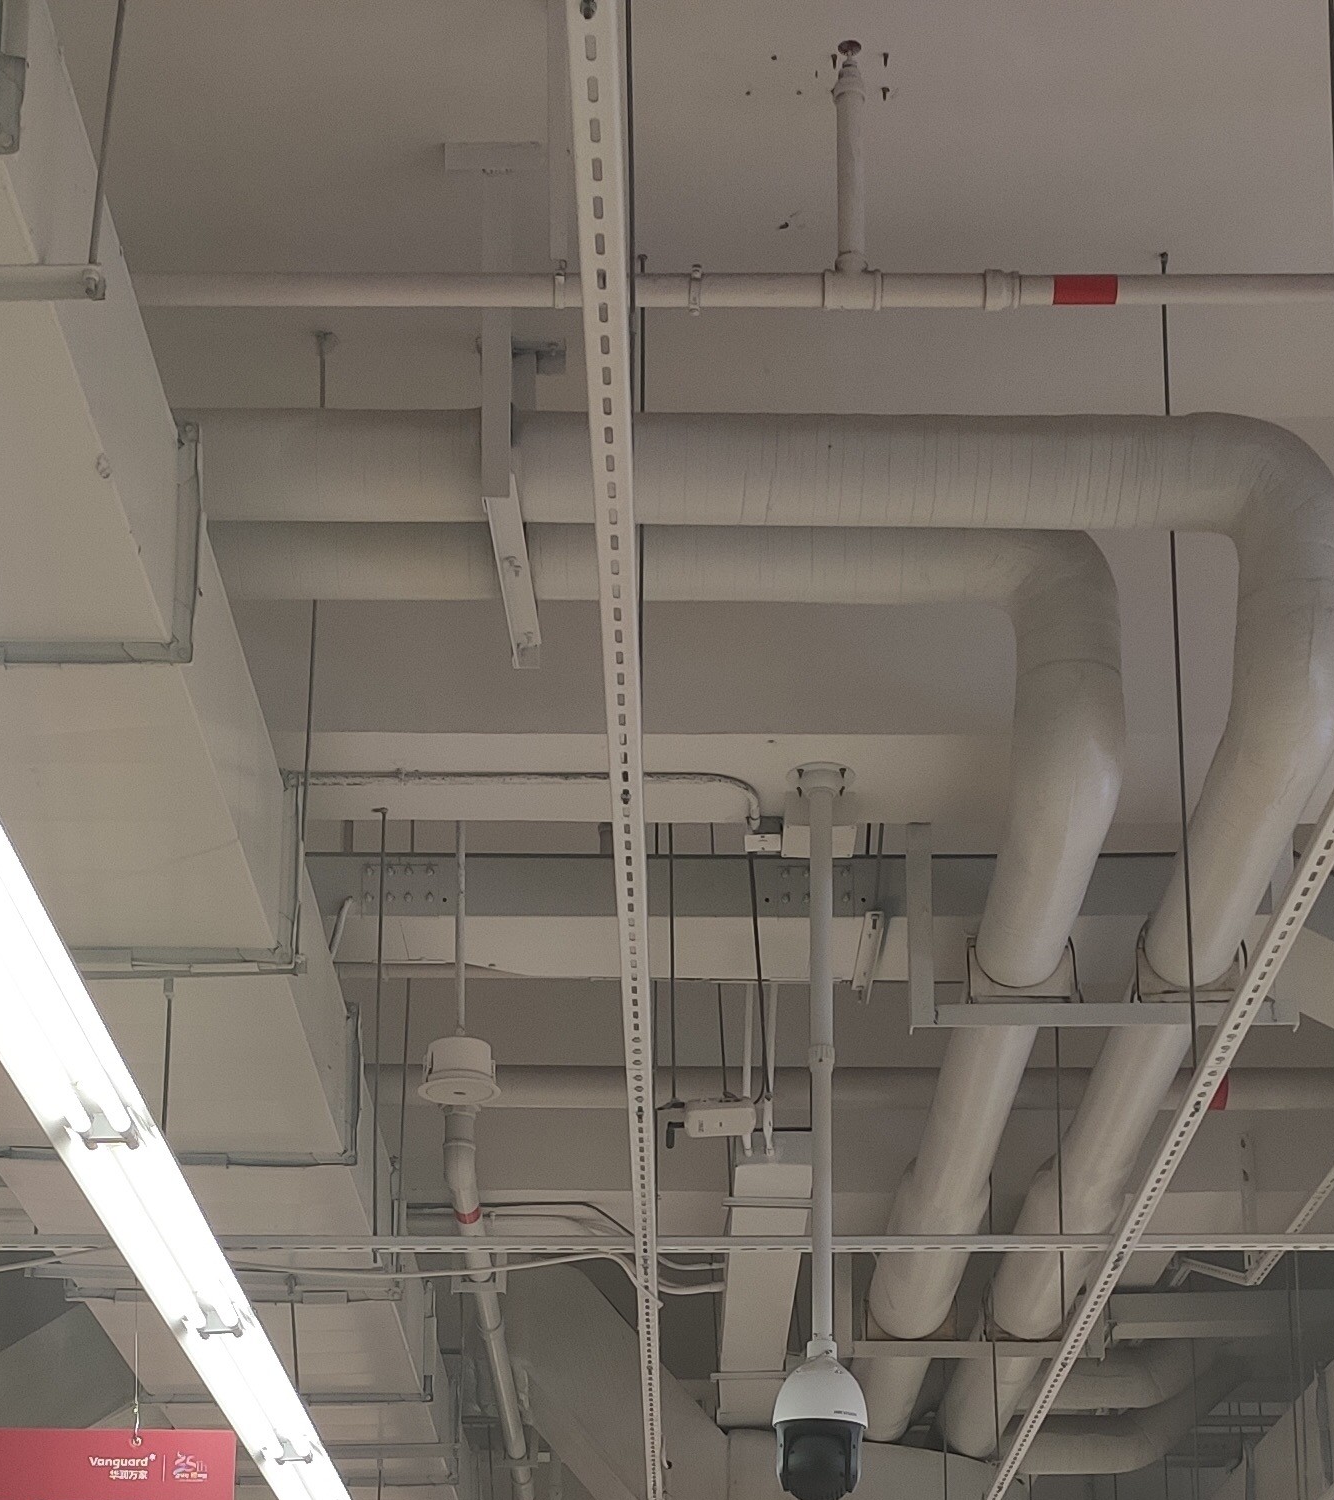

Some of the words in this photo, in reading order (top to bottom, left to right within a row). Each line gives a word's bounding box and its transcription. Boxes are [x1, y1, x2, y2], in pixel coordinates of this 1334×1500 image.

[89, 1456, 149, 1468] Vanguard
[109, 1469, 148, 1480] 华润万家
